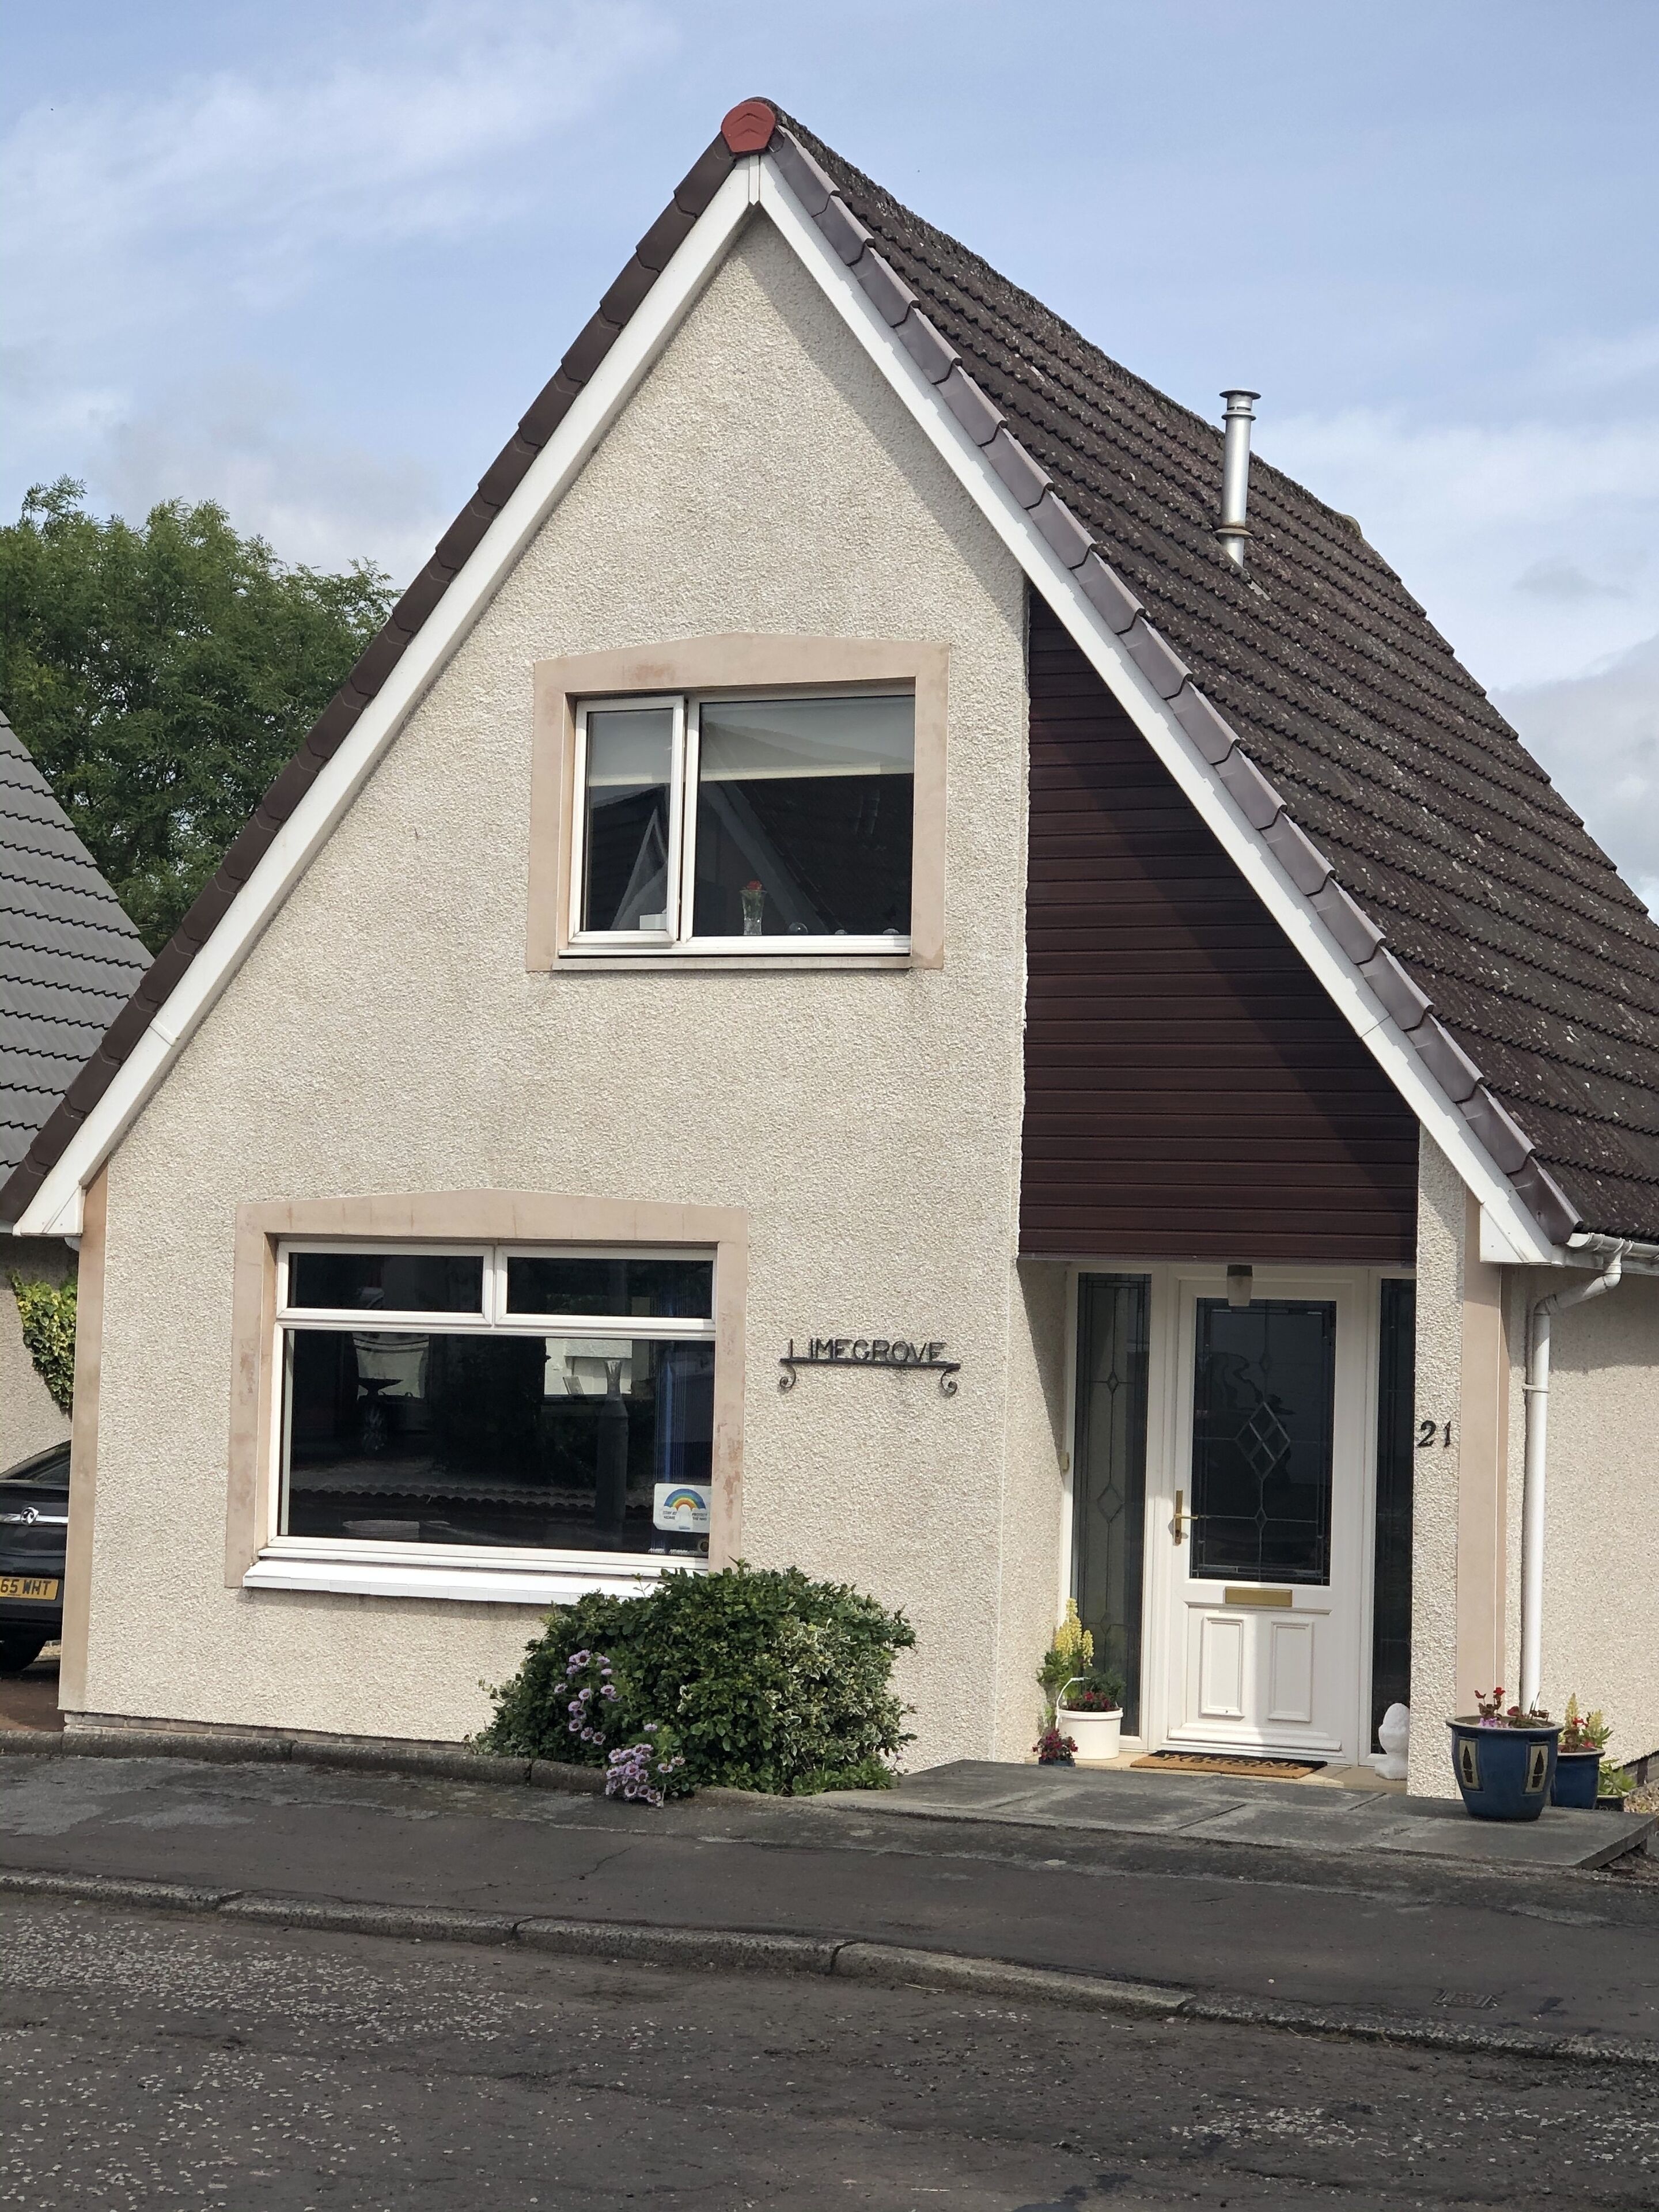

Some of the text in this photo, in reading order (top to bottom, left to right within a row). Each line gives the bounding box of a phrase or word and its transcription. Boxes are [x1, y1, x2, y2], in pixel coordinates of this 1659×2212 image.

[789, 1339, 946, 1362] LIMEGROVE
[1418, 1420, 1451, 1448] 21
[1, 1578, 20, 1593] 65
